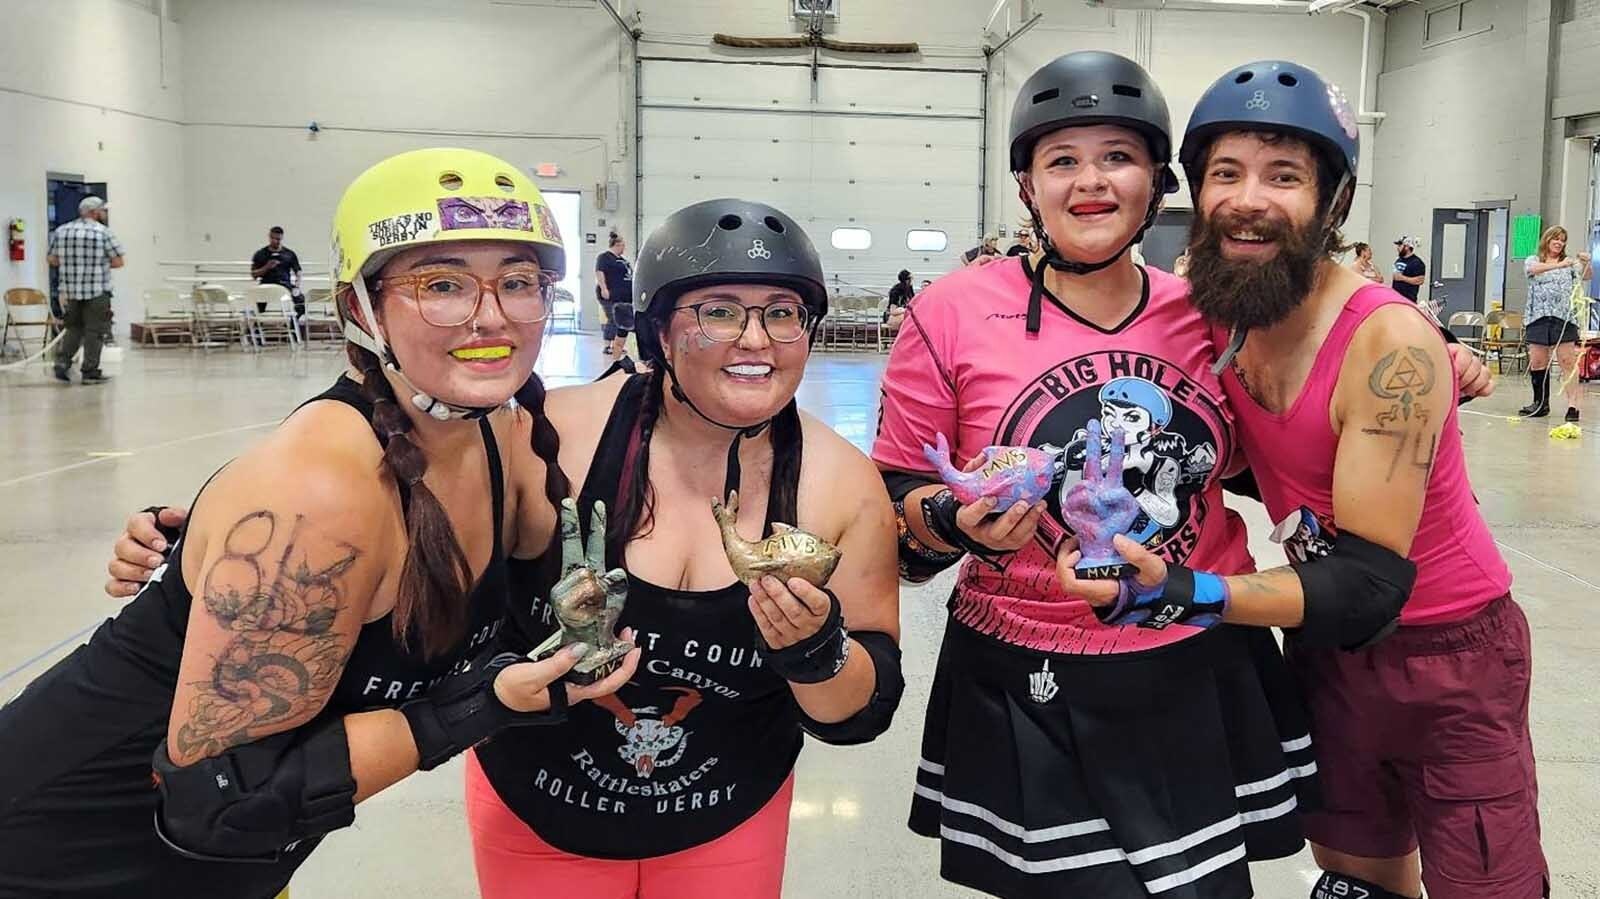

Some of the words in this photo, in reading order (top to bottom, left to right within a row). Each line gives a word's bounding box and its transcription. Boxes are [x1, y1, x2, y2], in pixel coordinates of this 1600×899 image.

[414, 219, 428, 234] IN
[416, 212, 432, 222] NO
[380, 231, 419, 246] DERBY
[1041, 358, 1098, 400] BIG
[1108, 352, 1197, 401] HOLE
[983, 450, 1026, 478] MVB
[764, 535, 818, 556] MVB
[1087, 565, 1123, 579] MVJ
[684, 640, 763, 668] COUN
[595, 658, 618, 680] MV
[647, 659, 740, 698] Canyon
[570, 748, 719, 797] Rattleskaters
[534, 769, 626, 814] ROLLER
[656, 783, 736, 814] DERBY
[1321, 875, 1369, 899] 187
